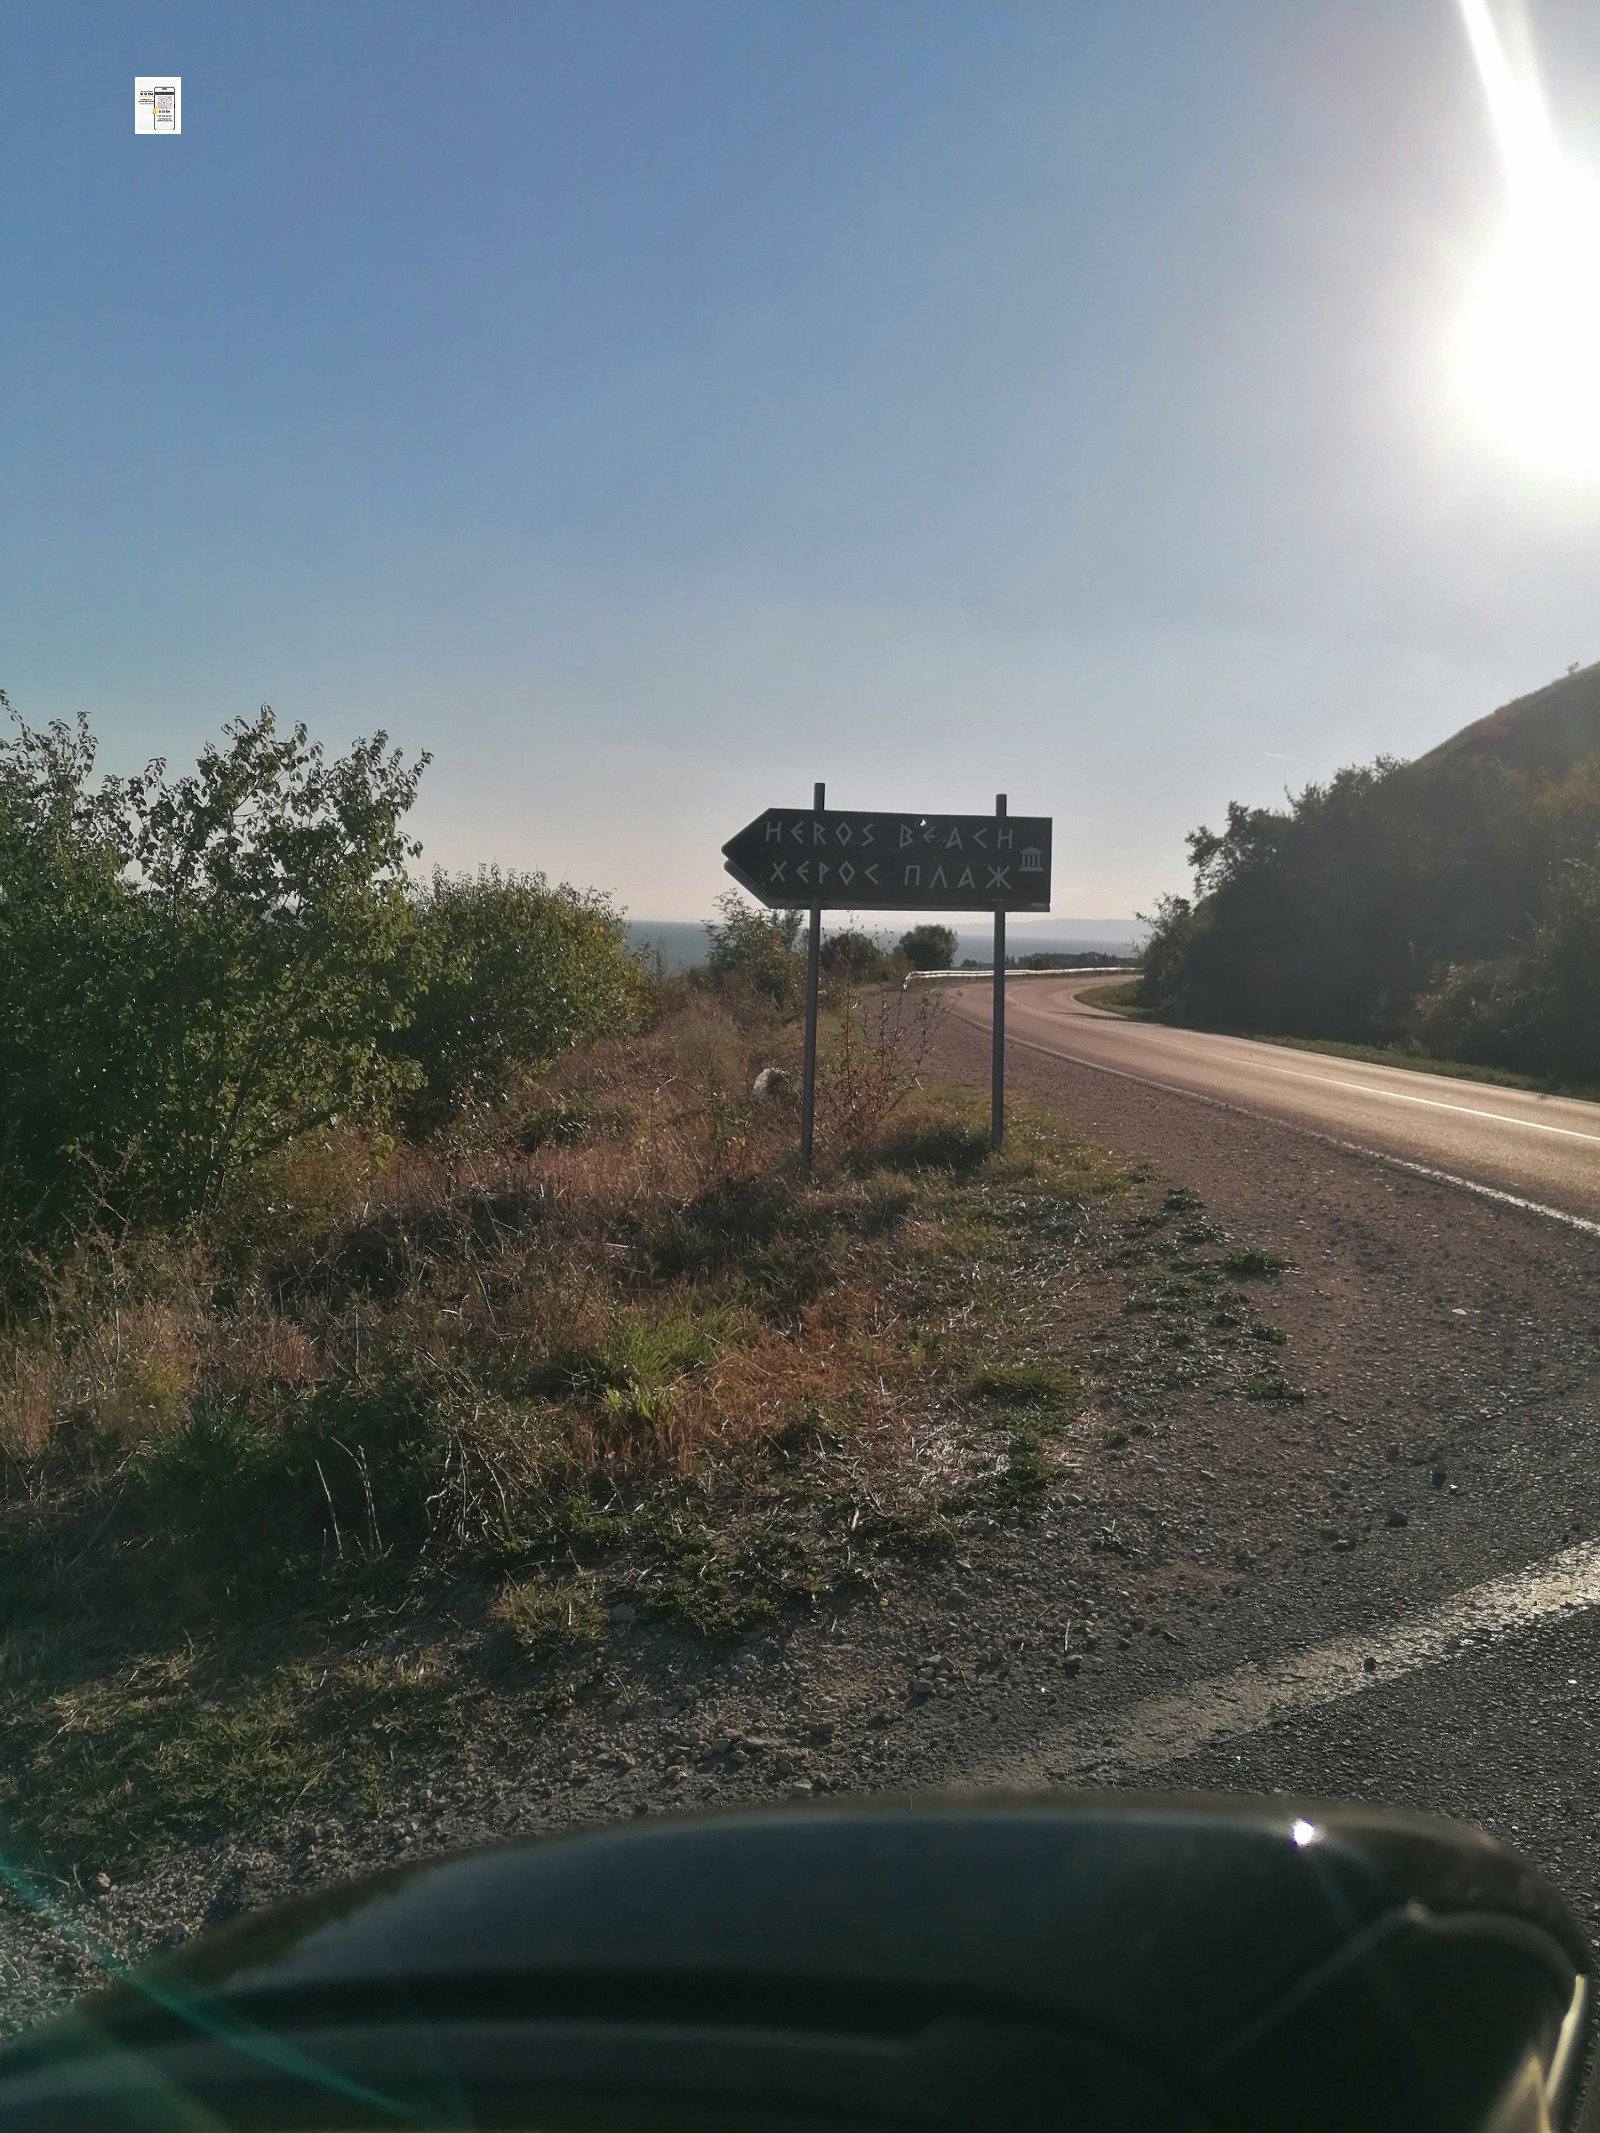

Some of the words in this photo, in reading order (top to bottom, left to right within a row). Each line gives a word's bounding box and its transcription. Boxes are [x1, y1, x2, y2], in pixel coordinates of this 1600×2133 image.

[765, 821, 875, 847] HEROS
[899, 823, 1013, 849] BEACH
[770, 860, 879, 886] ХЕРОС
[904, 865, 1011, 889] ПЛАЖ
